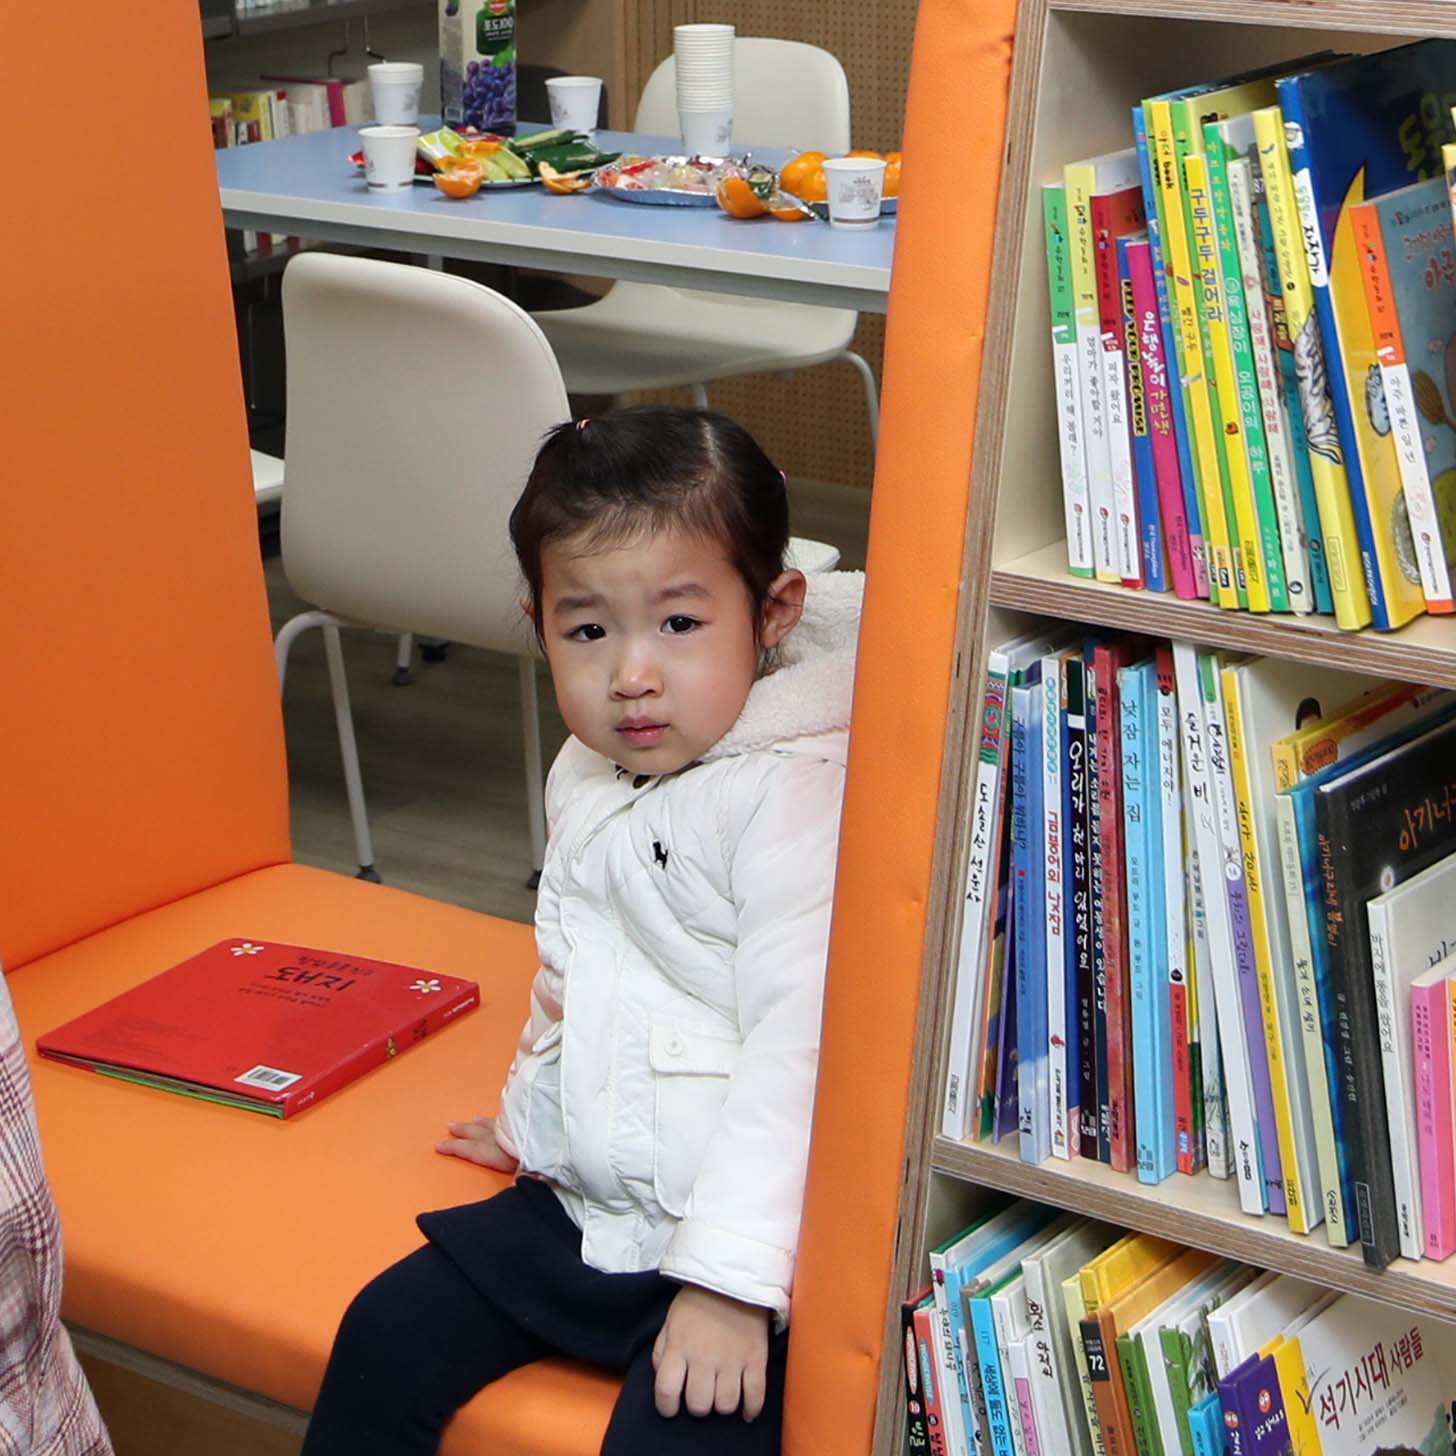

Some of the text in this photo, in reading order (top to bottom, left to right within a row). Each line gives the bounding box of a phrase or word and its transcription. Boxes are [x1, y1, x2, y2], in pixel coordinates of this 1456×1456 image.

[1190, 188, 1216, 263] 구두구두
[1201, 268, 1224, 323] 걸어라
[1069, 740, 1086, 814] 오리가
[1121, 700, 1140, 823] 낮잠 자는 집
[973, 782, 990, 849] 도솔산
[1088, 1354, 1106, 1371] 72
[1320, 1340, 1391, 1431] 석기시대
[1390, 1325, 1425, 1377] 사람들
